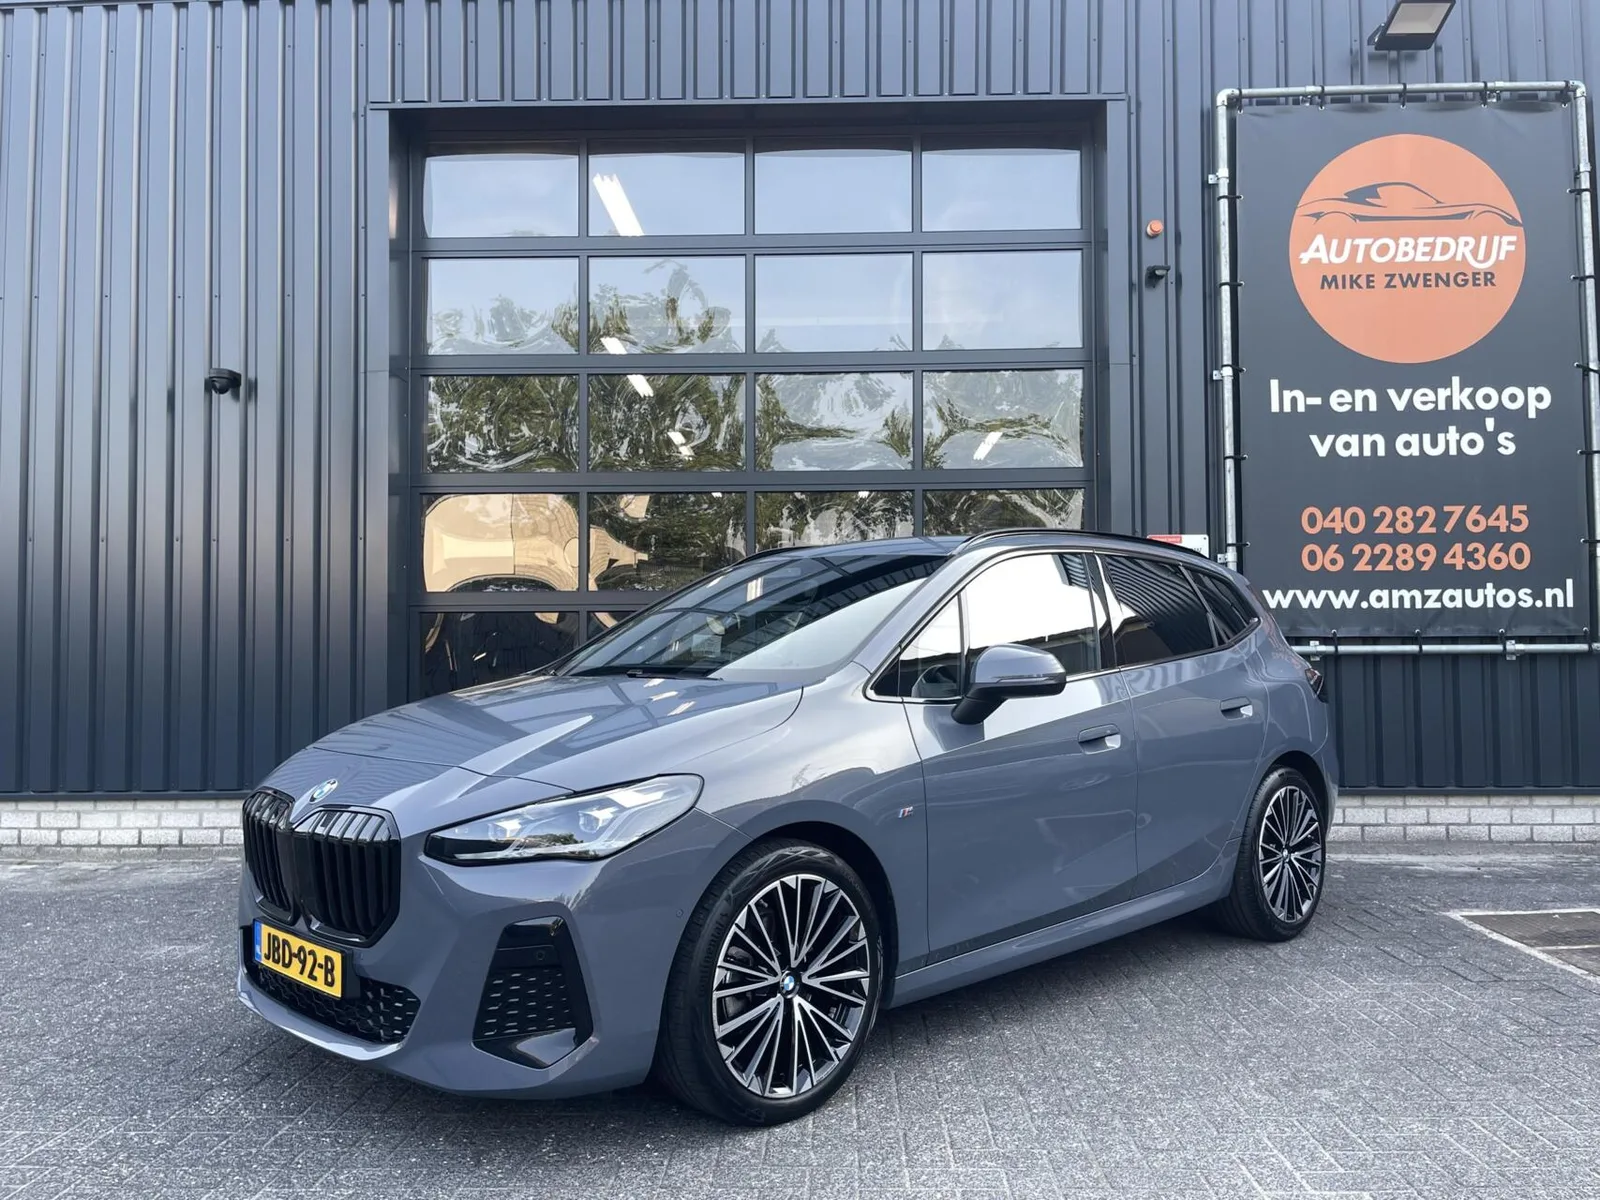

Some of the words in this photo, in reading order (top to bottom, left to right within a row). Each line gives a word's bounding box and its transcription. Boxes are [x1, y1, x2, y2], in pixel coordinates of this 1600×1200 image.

[1298, 233, 1517, 269] AUTOBEDRIJF
[1320, 274, 1375, 290] MIKE
[1384, 271, 1496, 289] ZWENGER
[1329, 387, 1377, 413] en
[1386, 375, 1552, 419] verkoop
[1309, 433, 1386, 458] van
[1395, 417, 1516, 457] auto's
[1301, 506, 1366, 534] 040
[1373, 505, 1436, 534] 282
[1444, 504, 1529, 533] 7645
[1301, 543, 1344, 572] 06
[1352, 543, 1436, 572] 2289
[1443, 541, 1531, 571] 4360
[1262, 578, 1574, 609] www.amzautos.nl
[264, 932, 335, 988] JBD-92-B
